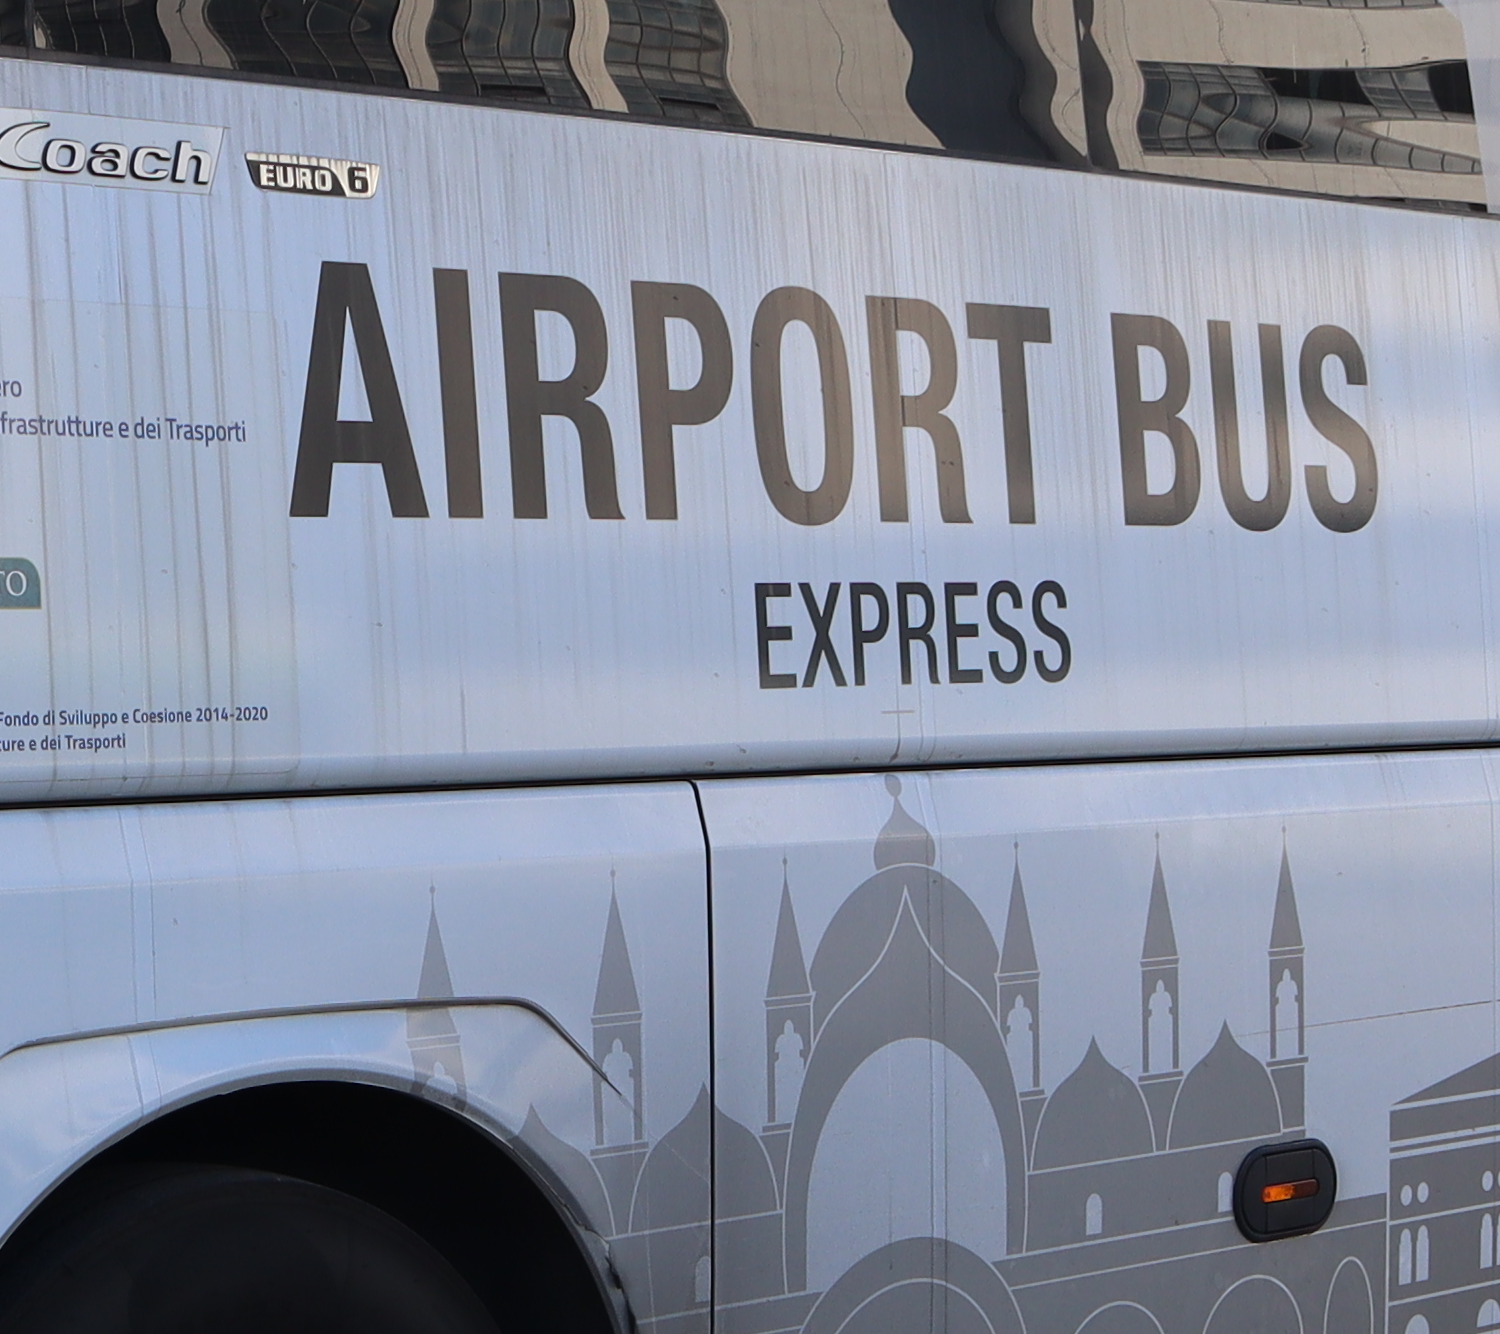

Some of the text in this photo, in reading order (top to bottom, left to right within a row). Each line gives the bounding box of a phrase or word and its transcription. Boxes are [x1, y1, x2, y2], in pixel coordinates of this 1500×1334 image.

[258, 164, 369, 194] EURO 6
[289, 259, 1379, 534] AIRPORT BUS
[118, 423, 129, 438] e
[134, 418, 161, 440] dei
[165, 418, 246, 447] Trasporti
[753, 578, 1072, 691] EXPRESS
[43, 710, 56, 726] di
[59, 709, 118, 733] Sviluppo
[121, 712, 130, 724] e
[132, 708, 192, 724] Coesione
[195, 707, 268, 722] 2014-2020
[28, 740, 37, 751] e
[40, 735, 62, 750] dei
[65, 733, 126, 753] Trasporti
